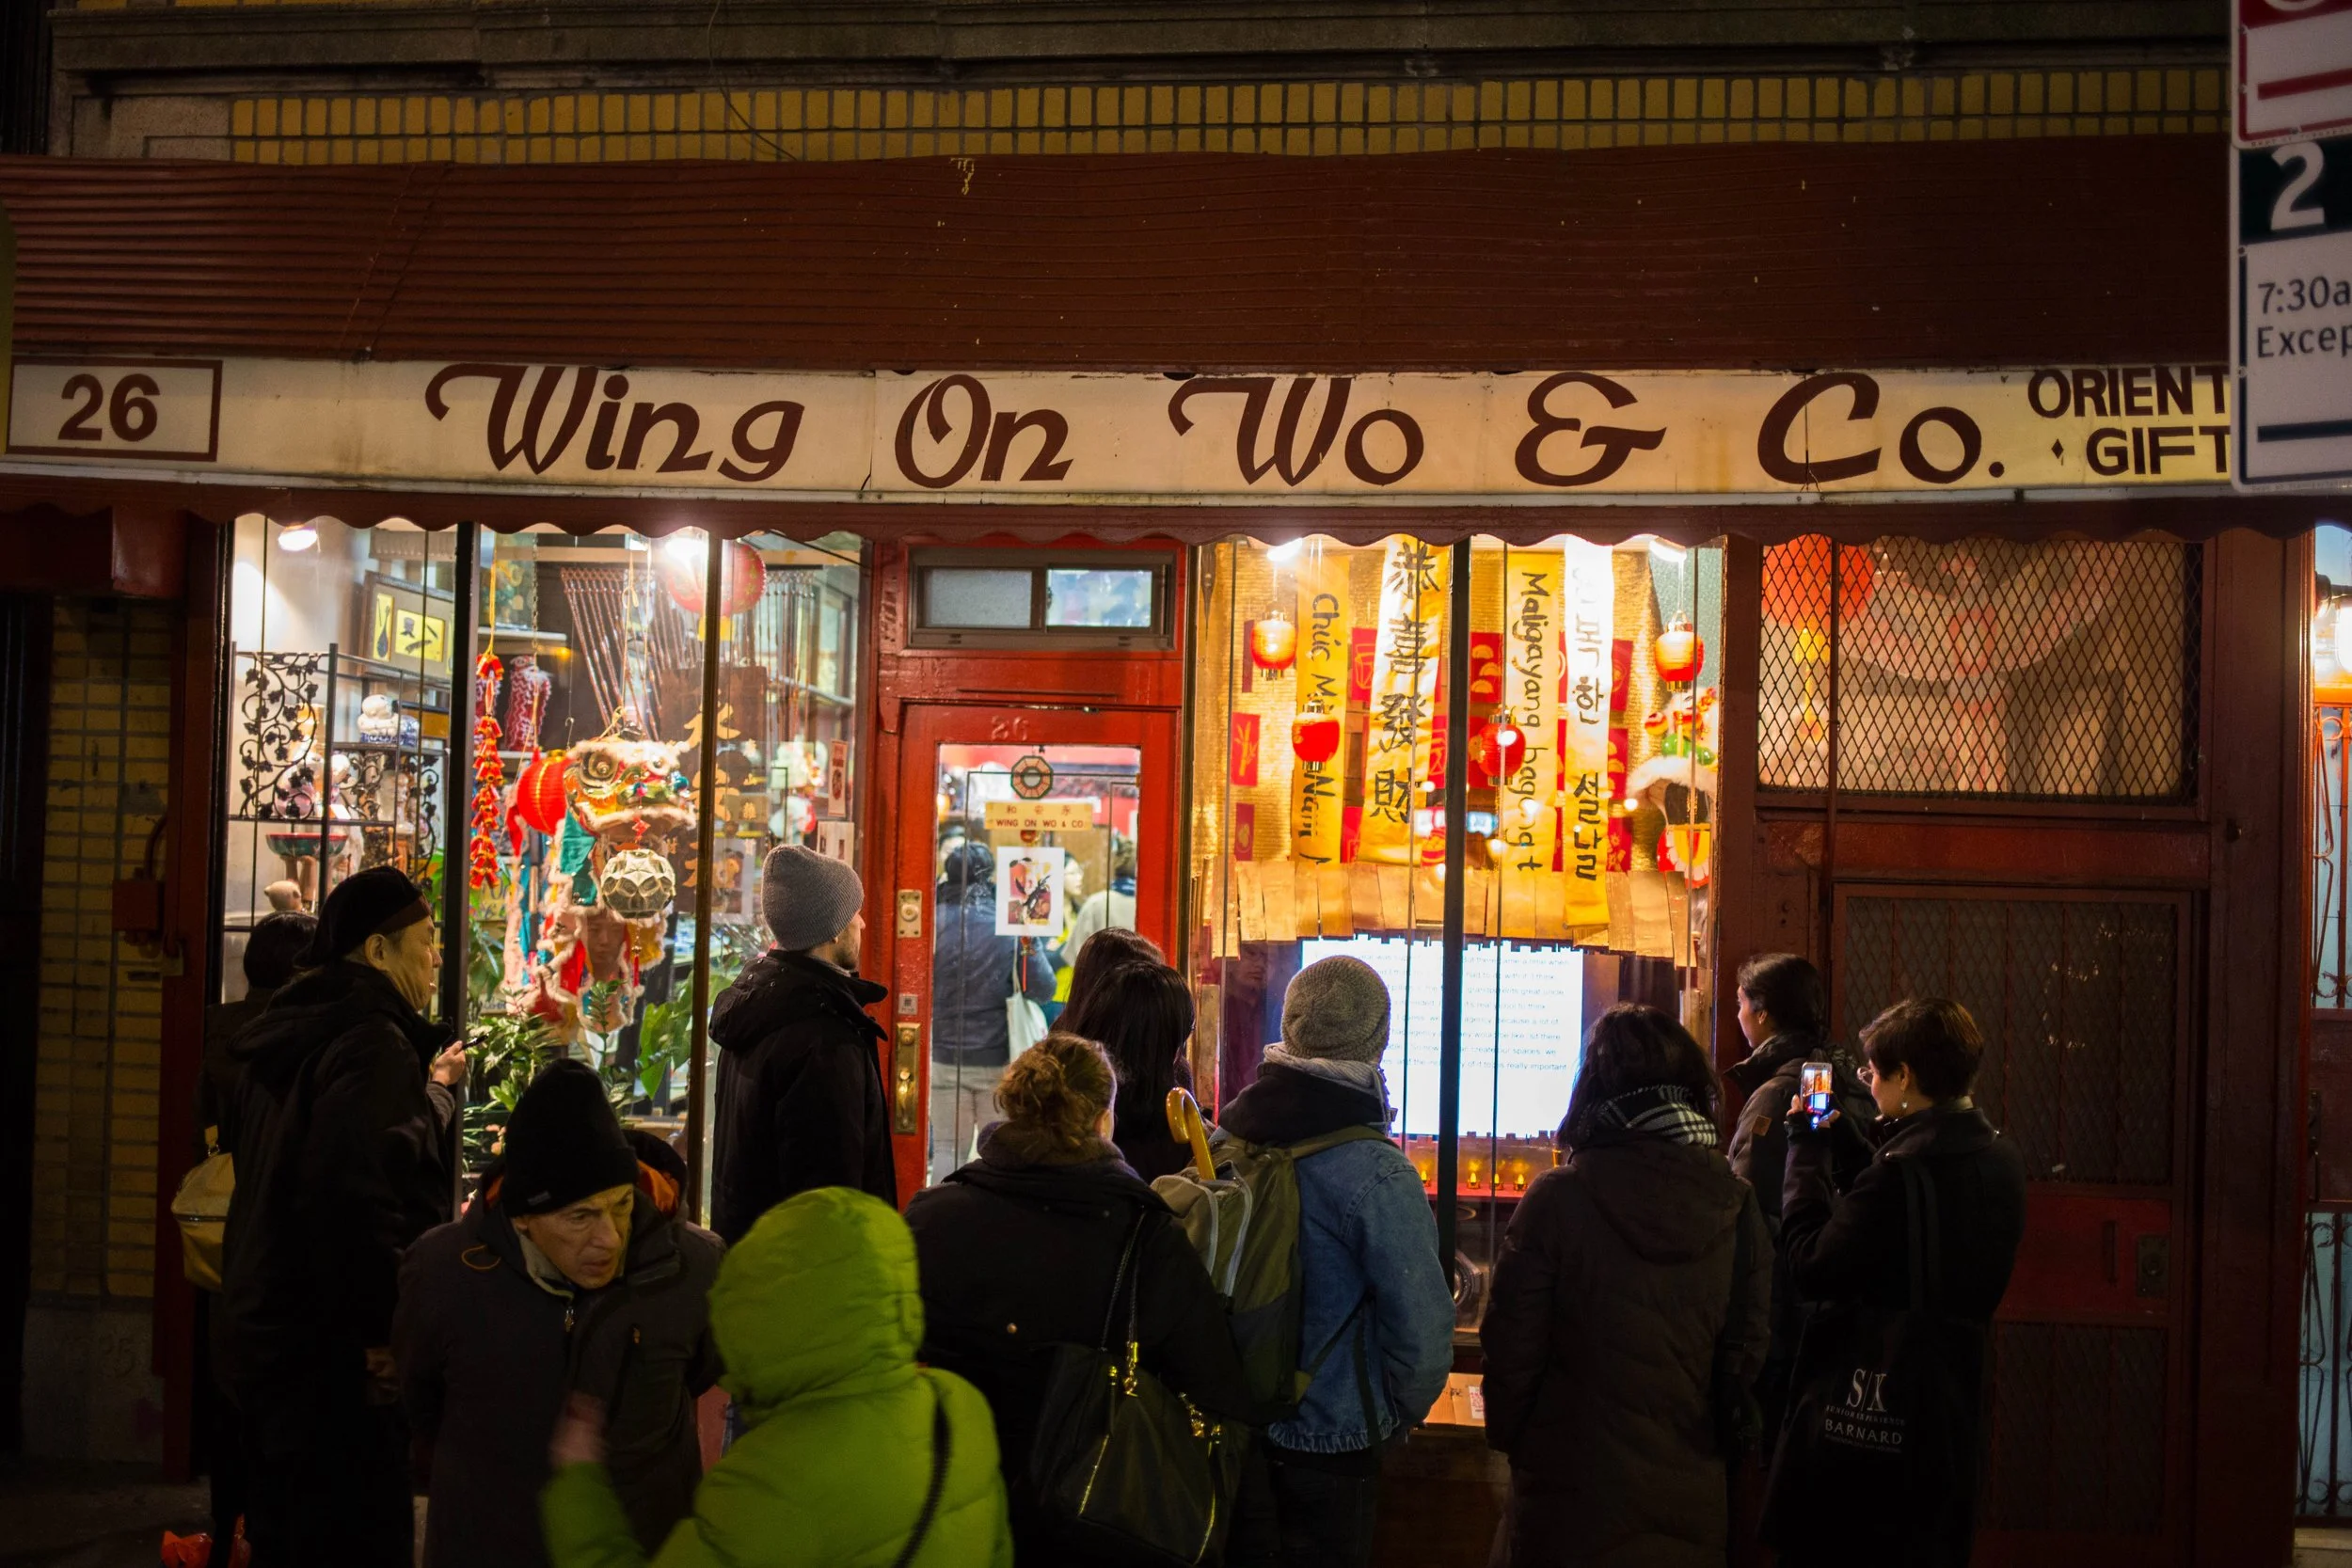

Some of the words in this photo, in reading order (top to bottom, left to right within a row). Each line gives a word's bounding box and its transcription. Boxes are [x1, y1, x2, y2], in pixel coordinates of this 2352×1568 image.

[2270, 140, 2326, 231] 2
[57, 373, 162, 442] 26
[424, 363, 806, 483] Wing
[894, 374, 1073, 489] On
[1168, 376, 1424, 486] Wo
[1515, 372, 1668, 487] &
[1757, 372, 2005, 484] Co.
[2027, 366, 2231, 419] ORIENT
[2086, 426, 2231, 476] GIFT
[1311, 593, 1342, 662] Chúc
[1511, 571, 1551, 728] Maligayang
[1371, 541, 1440, 826] 恭喜發財
[995, 818, 1019, 828] WING
[1024, 819, 1038, 829] ON
[1042, 819, 1057, 829] WO
[1573, 771, 1603, 881] 설날
[1825, 1418, 1903, 1446] BARNARD
